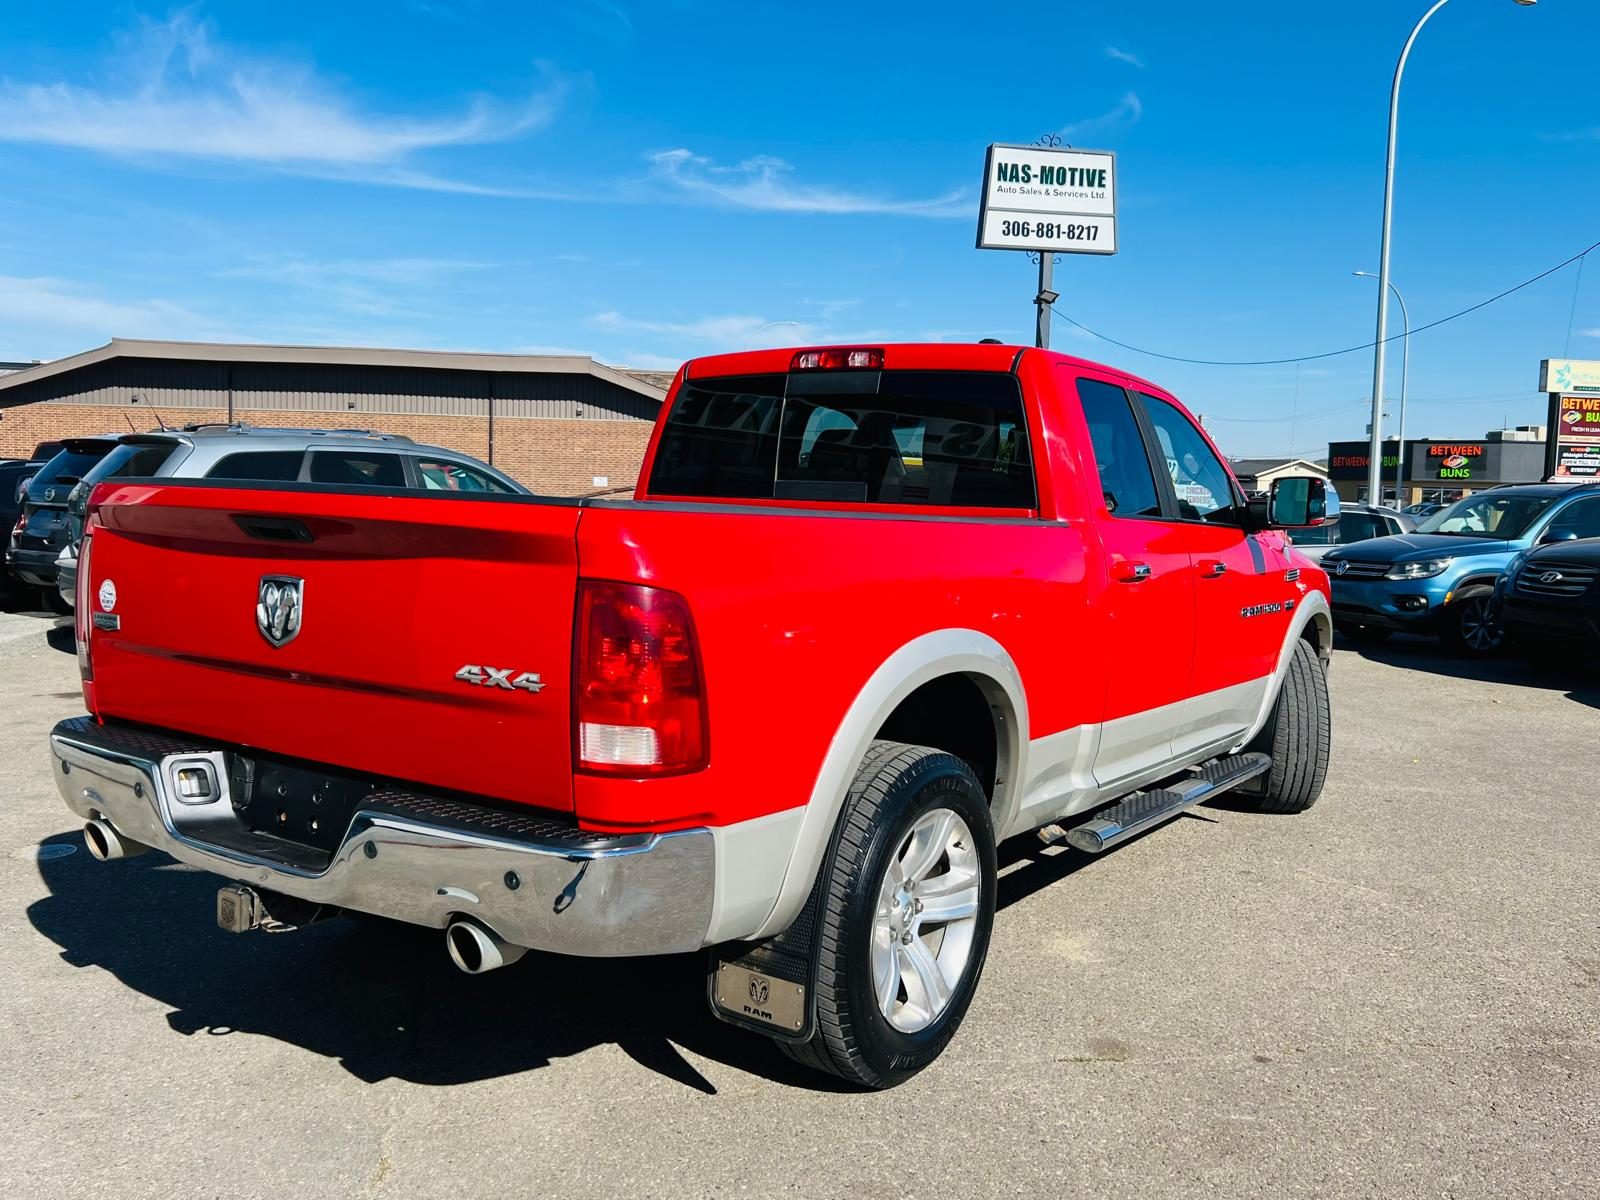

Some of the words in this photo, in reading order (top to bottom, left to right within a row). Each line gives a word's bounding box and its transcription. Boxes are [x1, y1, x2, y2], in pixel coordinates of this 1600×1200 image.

[997, 162, 1106, 188] NAS-MOTIVE
[997, 185, 1017, 194] Auto
[1019, 187, 1042, 195] Sales
[1044, 188, 1050, 196] &
[1053, 189, 1089, 198] Services
[1091, 191, 1107, 199] Ltd.
[1002, 220, 1099, 241] 306-881-8217
[1586, 412, 1600, 422] BU
[1431, 446, 1482, 455] BETWEEN
[1333, 456, 1366, 467] BETWEEN
[1383, 456, 1400, 467] BUN
[1440, 468, 1470, 478] BUNS
[455, 664, 547, 692] 4X4
[743, 1005, 772, 1020] RAM
